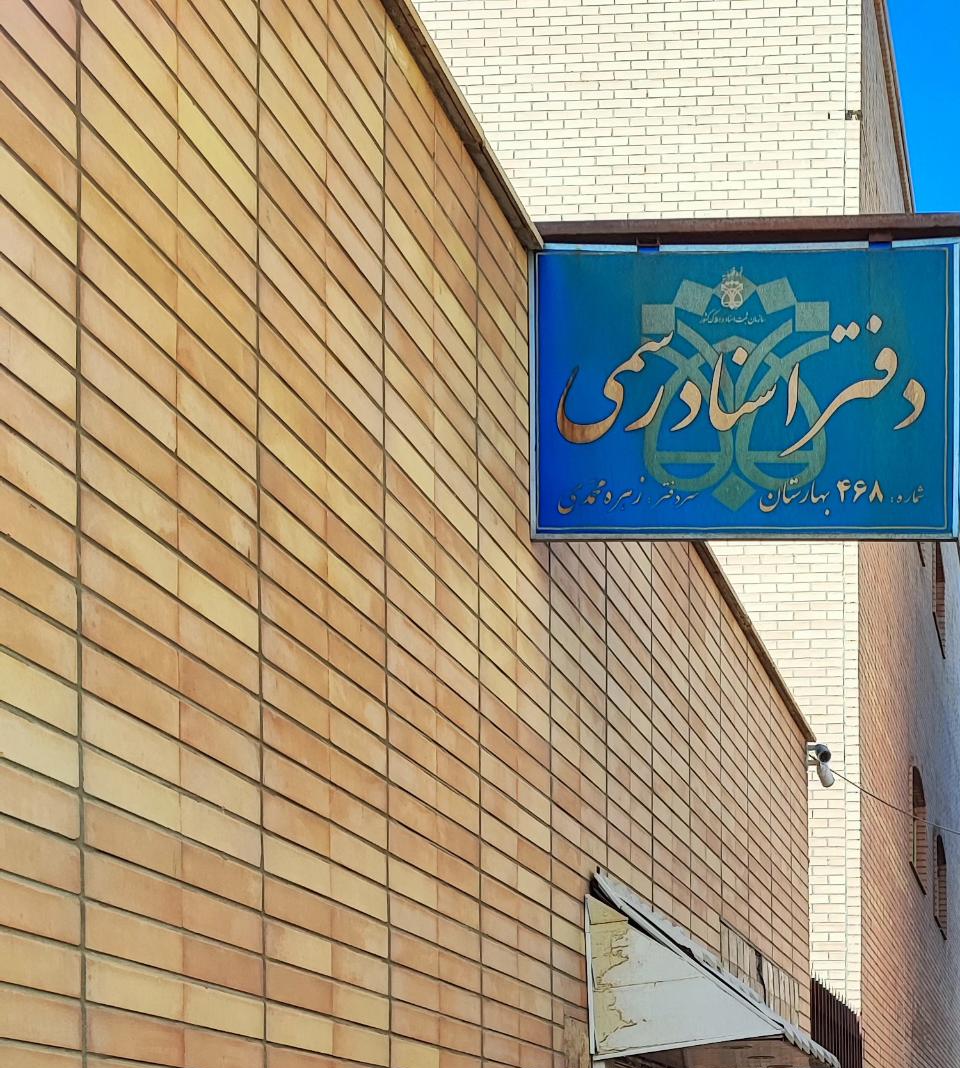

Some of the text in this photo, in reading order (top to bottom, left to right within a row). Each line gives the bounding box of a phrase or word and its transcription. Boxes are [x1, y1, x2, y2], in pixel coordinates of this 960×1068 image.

[557, 315, 926, 457] دفتر اسناد رسمی
[759, 478, 830, 516] بهارستان
[836, 479, 884, 503] ۴۶۸
